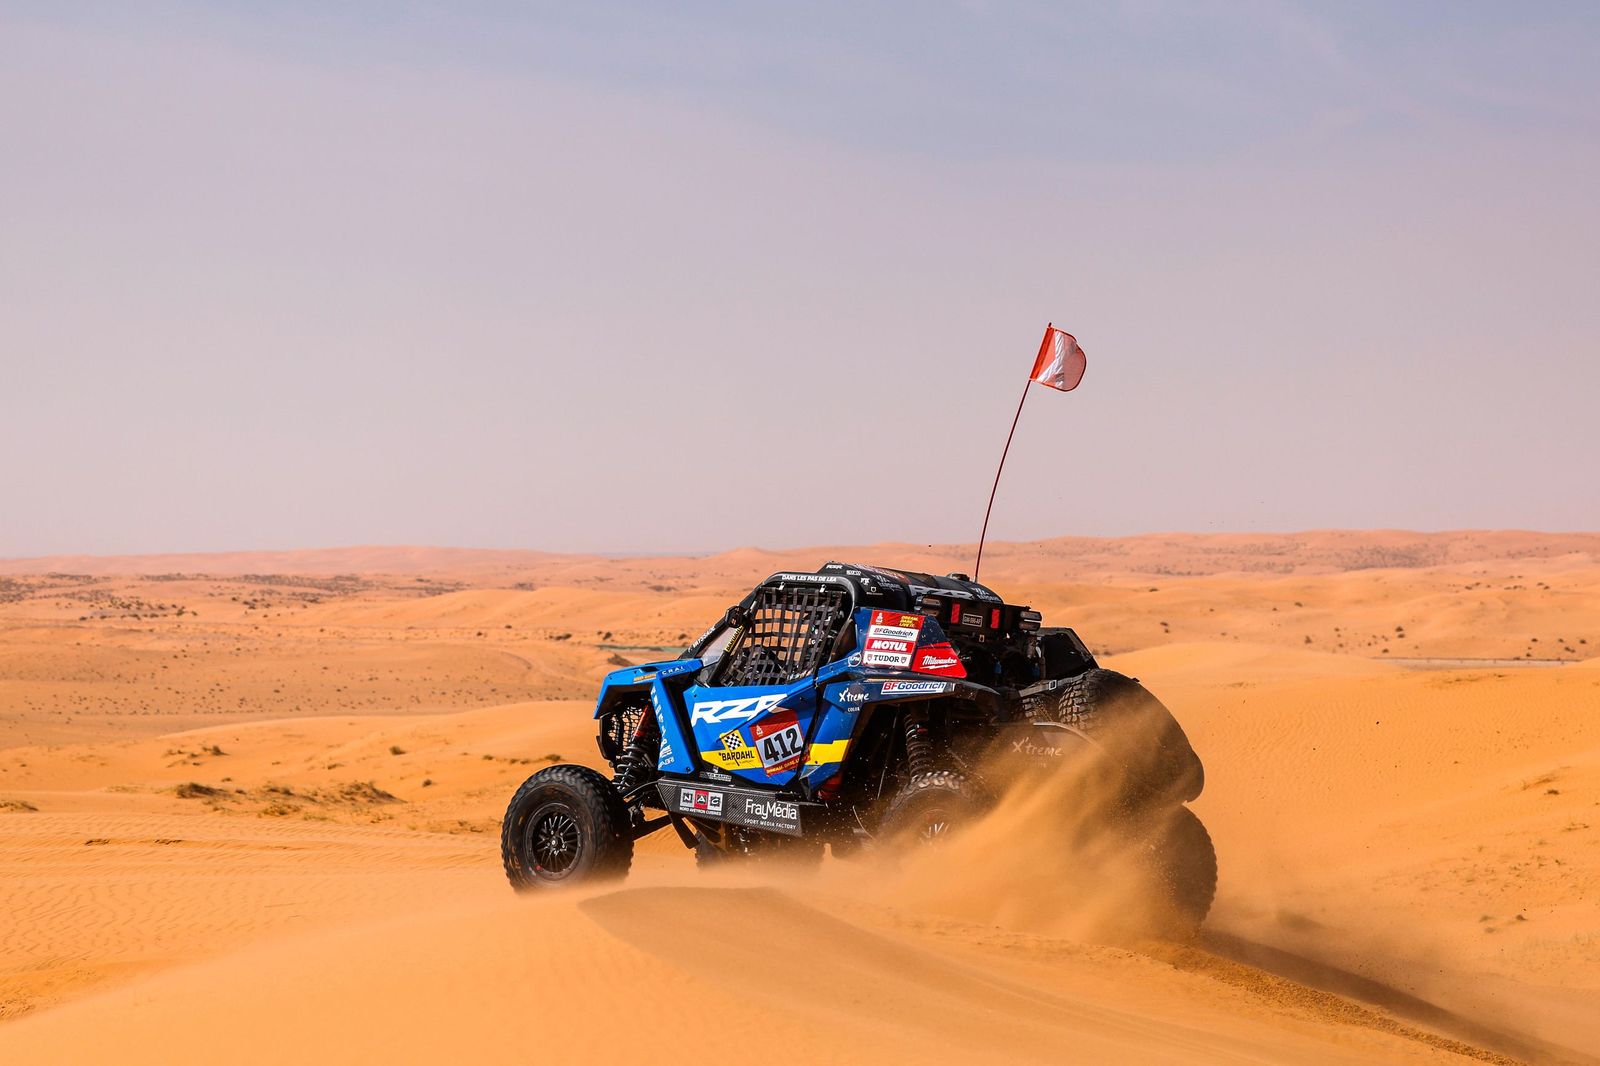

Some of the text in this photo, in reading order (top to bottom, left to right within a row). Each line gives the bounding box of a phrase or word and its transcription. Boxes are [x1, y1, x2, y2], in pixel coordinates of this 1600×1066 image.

[873, 628, 914, 637] BFGoodrich
[871, 640, 907, 651] MOTUL
[922, 655, 957, 665] Milwaukee
[883, 682, 946, 691] BFGoodrich
[690, 693, 788, 727] RZR
[763, 728, 801, 762] 412
[721, 750, 755, 761] BARDAHL
[745, 799, 797, 820] FrayMédia
